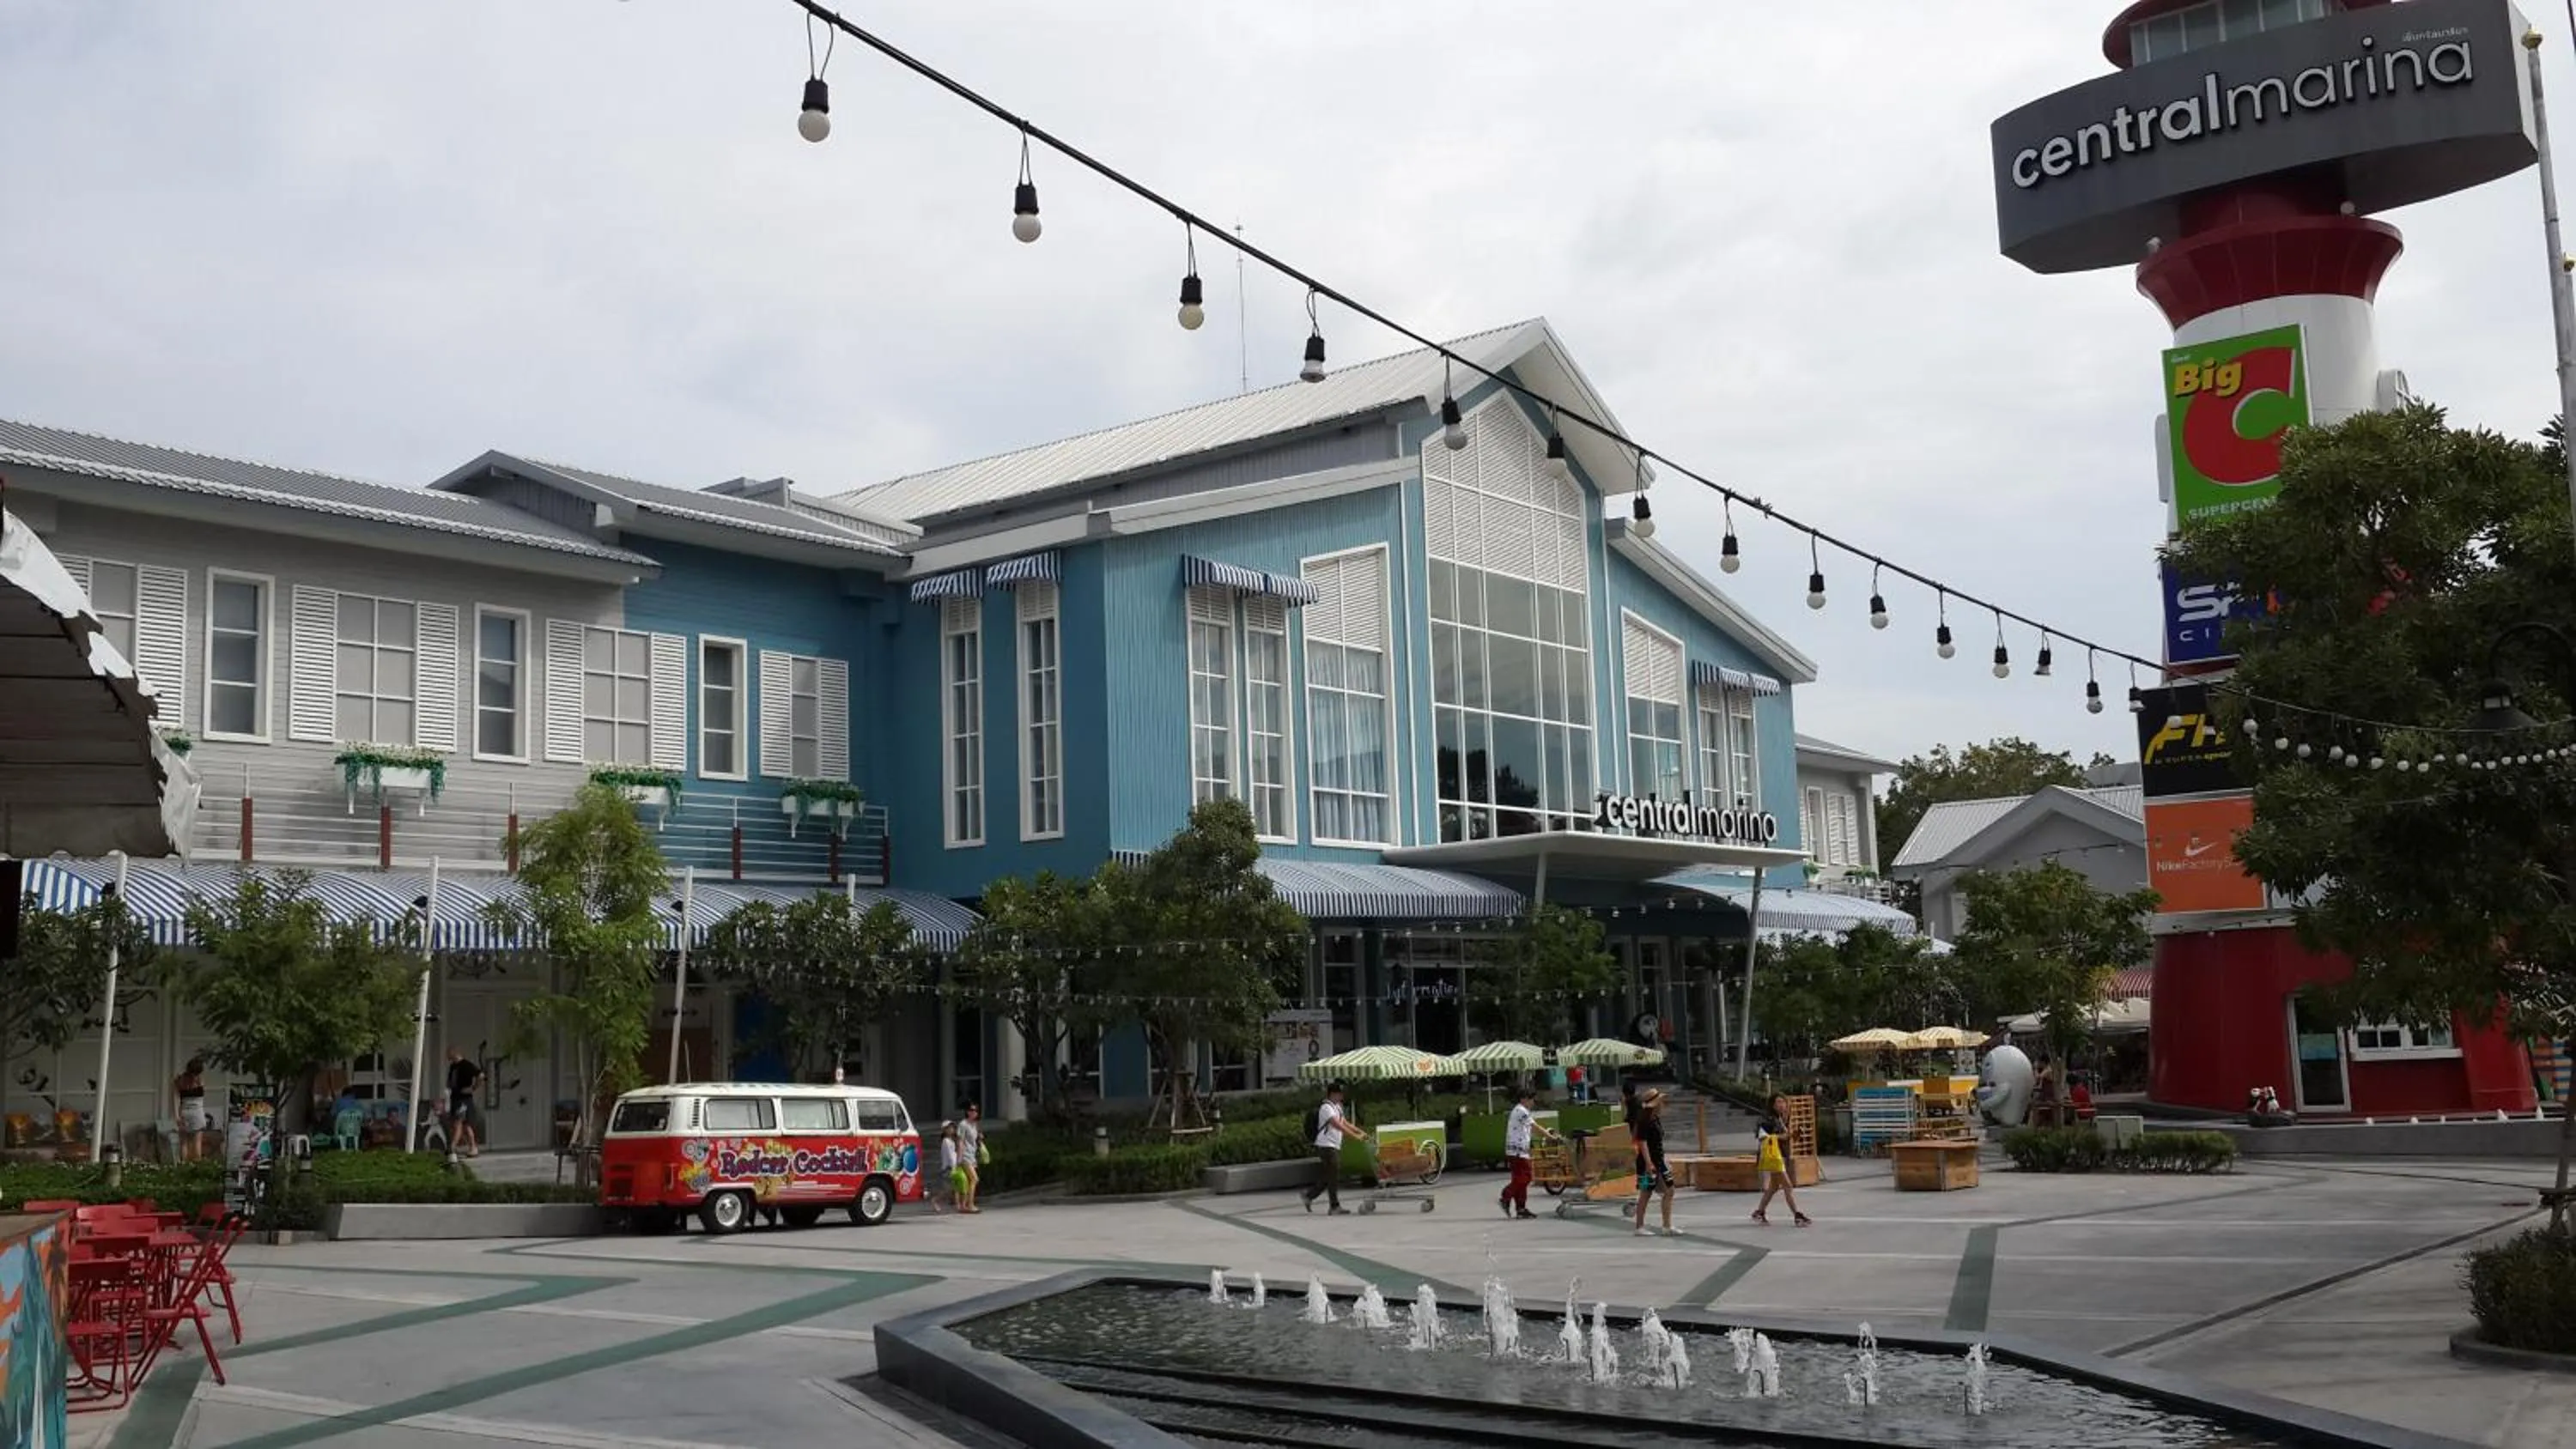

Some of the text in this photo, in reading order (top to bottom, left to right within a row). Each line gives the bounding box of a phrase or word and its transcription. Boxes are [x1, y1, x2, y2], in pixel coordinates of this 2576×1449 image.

[2011, 37, 2474, 190] centralmarina
[2173, 346, 2297, 487] Big C
[1606, 790, 1777, 842] centralmarina
